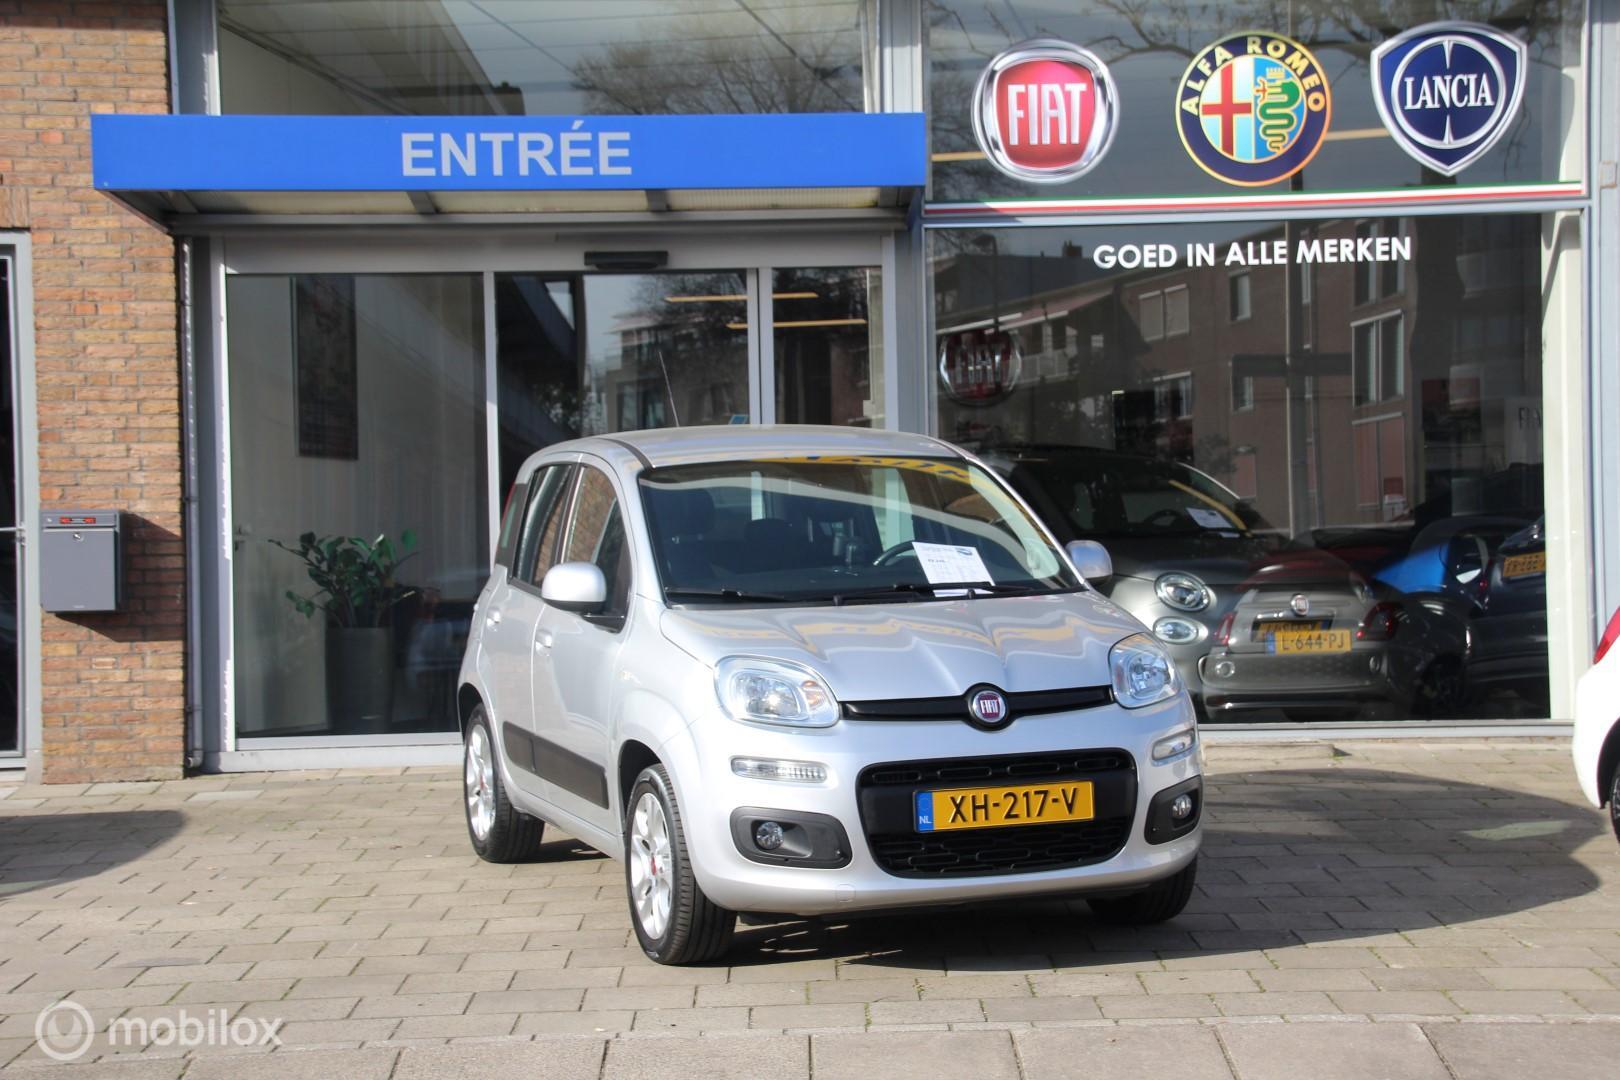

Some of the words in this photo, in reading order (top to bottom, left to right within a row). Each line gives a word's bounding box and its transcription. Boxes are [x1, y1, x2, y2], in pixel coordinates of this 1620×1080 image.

[1181, 42, 1233, 117] ALFA
[1246, 36, 1326, 113] ROMEO
[1404, 73, 1494, 110] LANCIA
[1008, 83, 1087, 145] FIAT
[401, 120, 632, 176] ENTRÉE
[1093, 244, 1177, 269] GOED
[1186, 243, 1215, 267] IN
[1225, 240, 1287, 265] ALLE
[1296, 237, 1411, 263] MERKEN
[980, 699, 1000, 713] FIAT
[919, 816, 932, 824] NL
[949, 787, 1078, 823] XH-217-V
